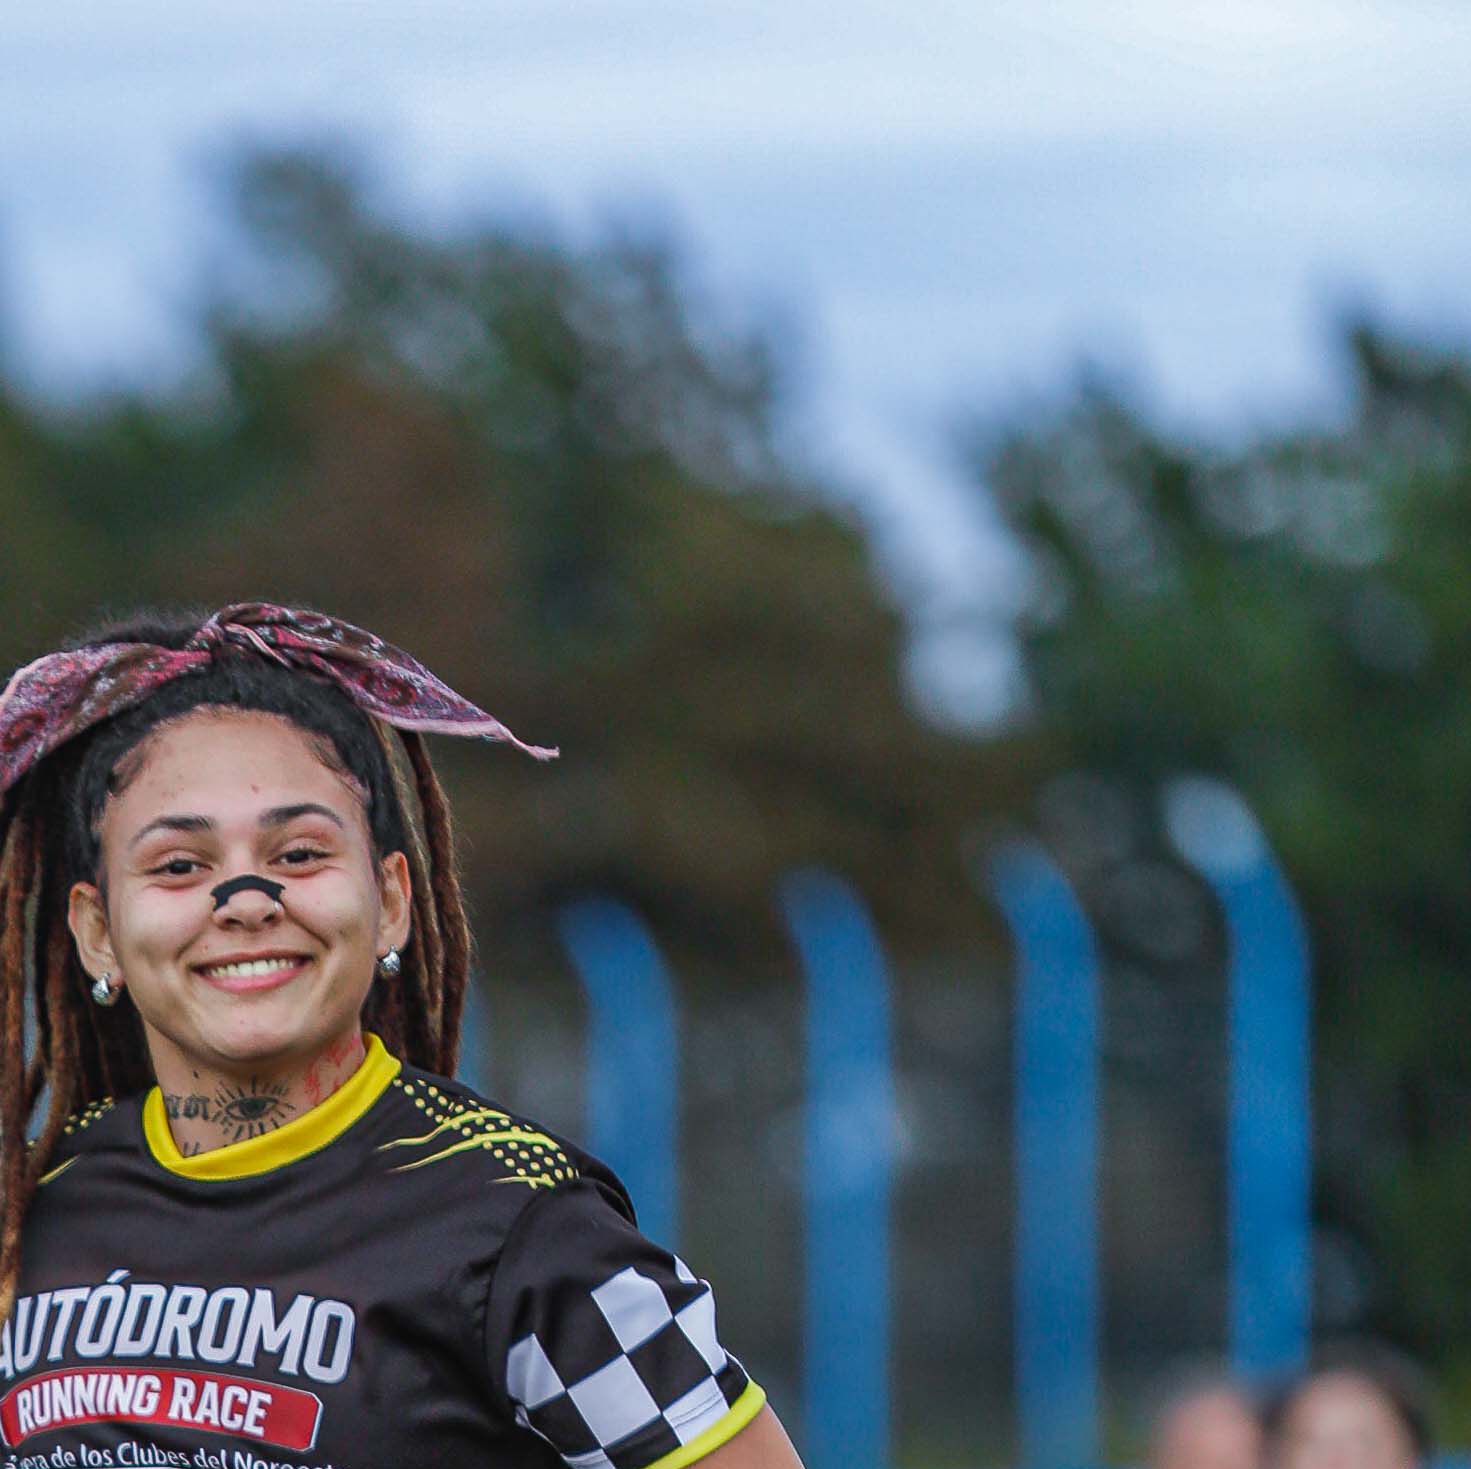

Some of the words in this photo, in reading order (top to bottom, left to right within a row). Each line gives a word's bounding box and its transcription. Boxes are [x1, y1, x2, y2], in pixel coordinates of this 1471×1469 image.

[16, 1373, 162, 1434] RUNNING
[167, 1376, 273, 1437] RACE
[50, 1444, 78, 1469] de
[80, 1442, 113, 1467] los
[116, 1441, 190, 1469] Clubes
